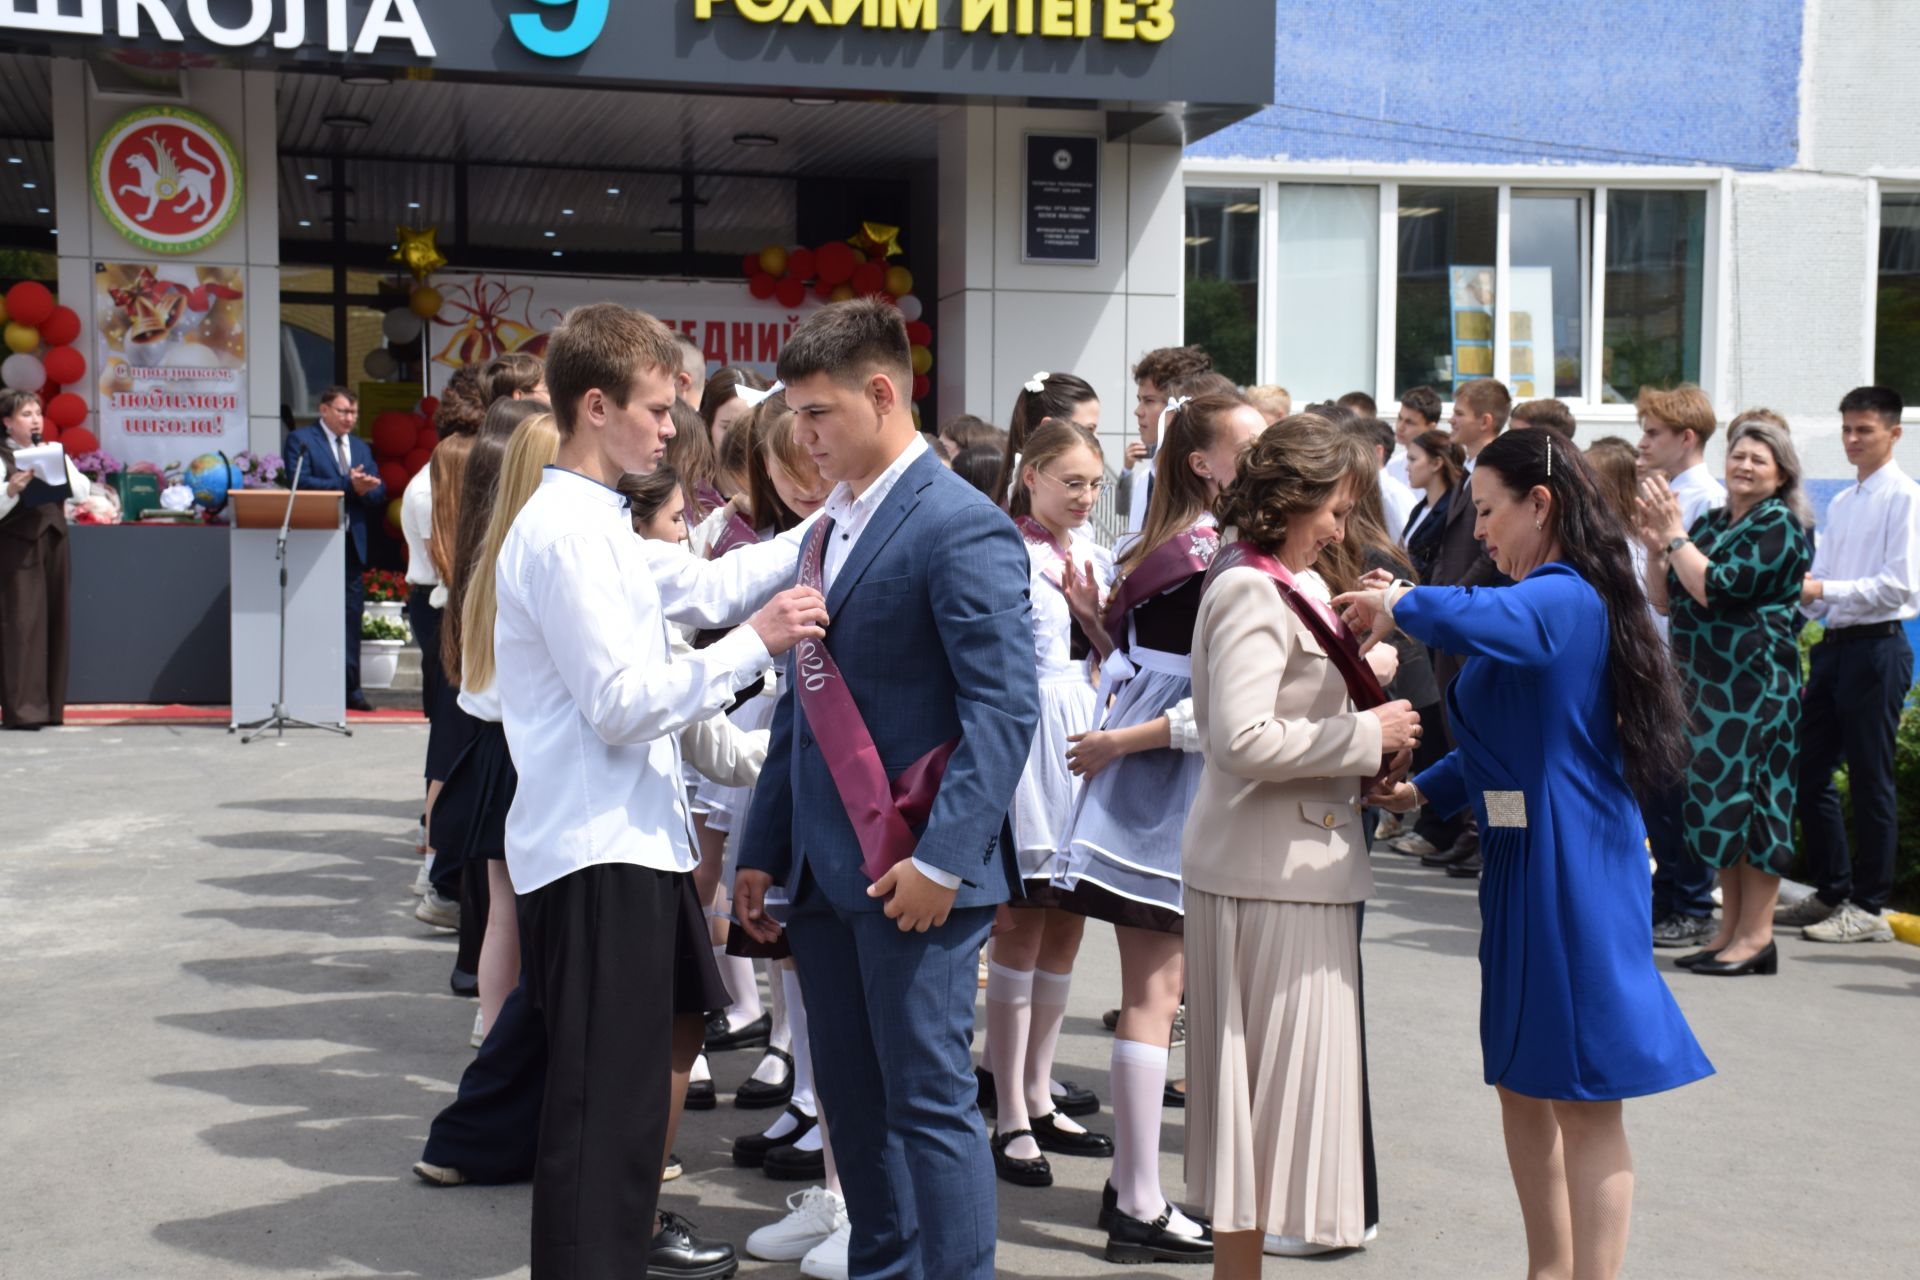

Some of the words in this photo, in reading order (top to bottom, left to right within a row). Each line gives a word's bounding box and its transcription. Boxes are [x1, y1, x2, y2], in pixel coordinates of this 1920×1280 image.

[111, 388, 237, 410] любимая
[125, 416, 223, 433] школа!
[800, 638, 836, 691] 026
